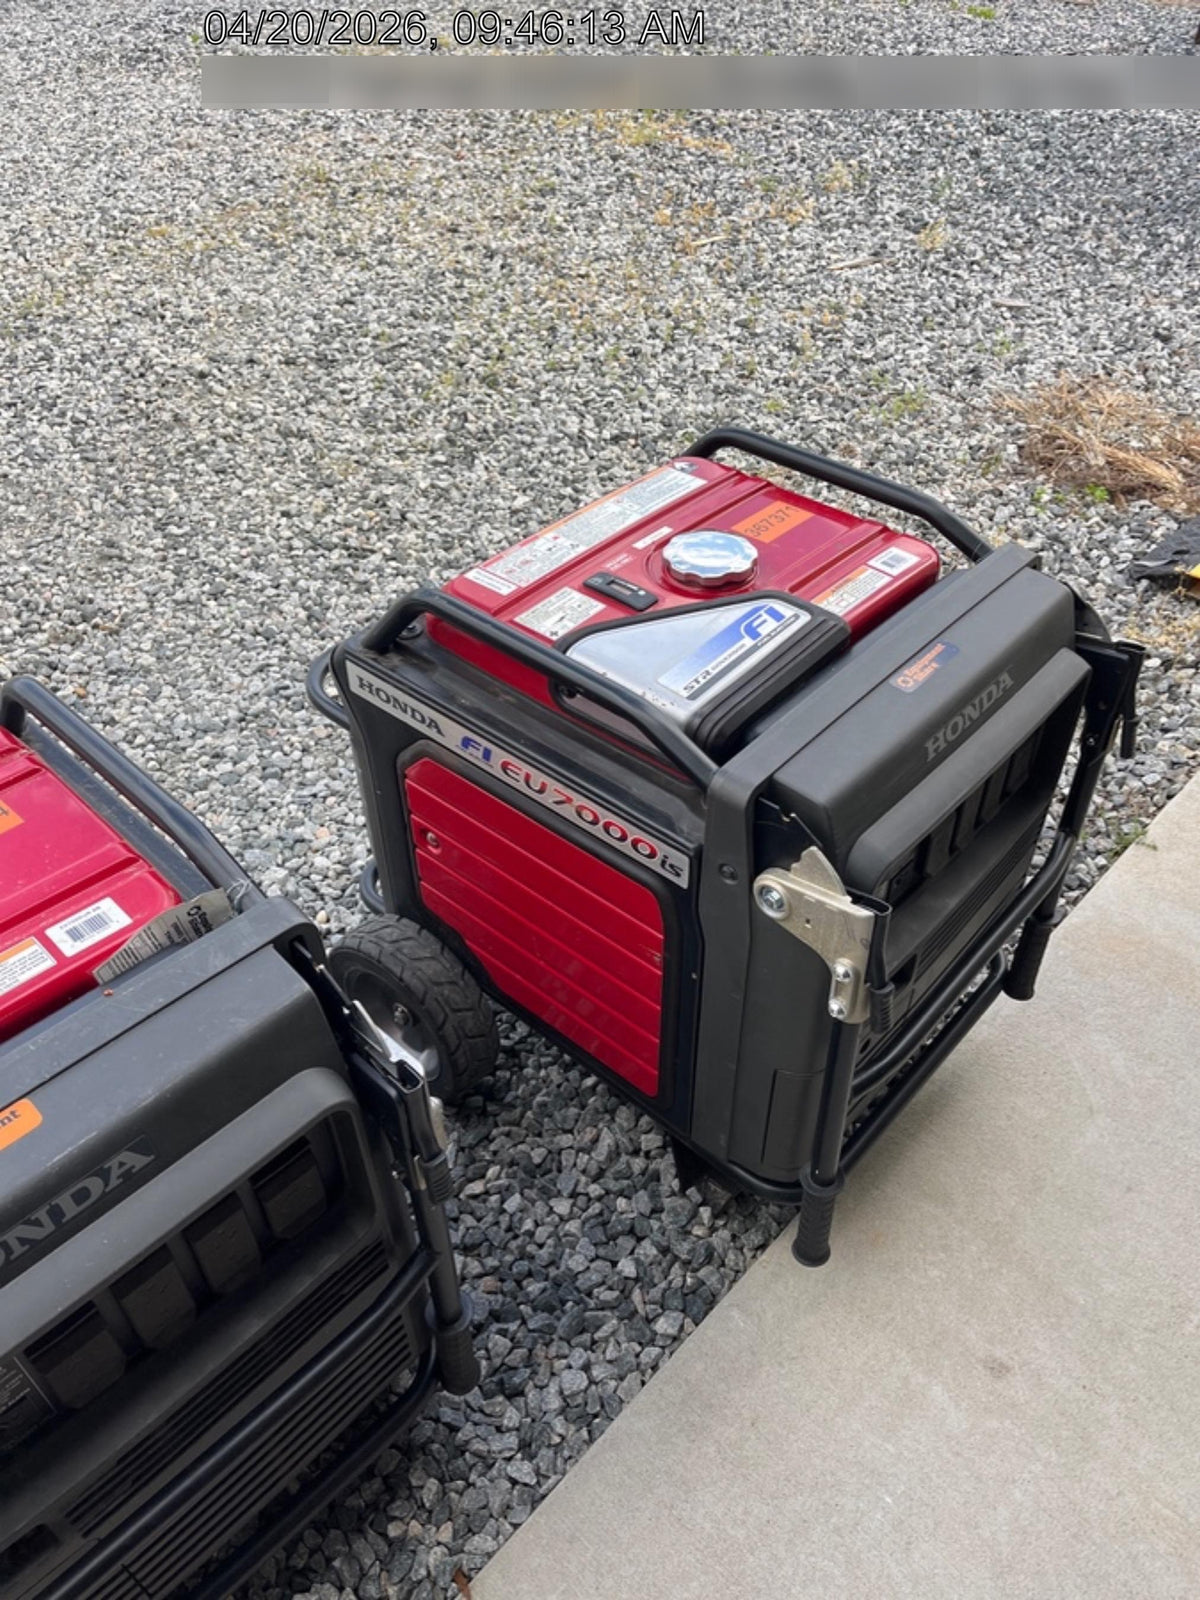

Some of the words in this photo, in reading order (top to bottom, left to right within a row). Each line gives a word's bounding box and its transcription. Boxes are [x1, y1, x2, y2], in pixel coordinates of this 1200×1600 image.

[924, 671, 1014, 762] HONDA
[356, 675, 445, 738] HONDA
[460, 735, 492, 763] FI
[500, 759, 685, 880] EU7000is
[0, 1151, 155, 1269] NDA
